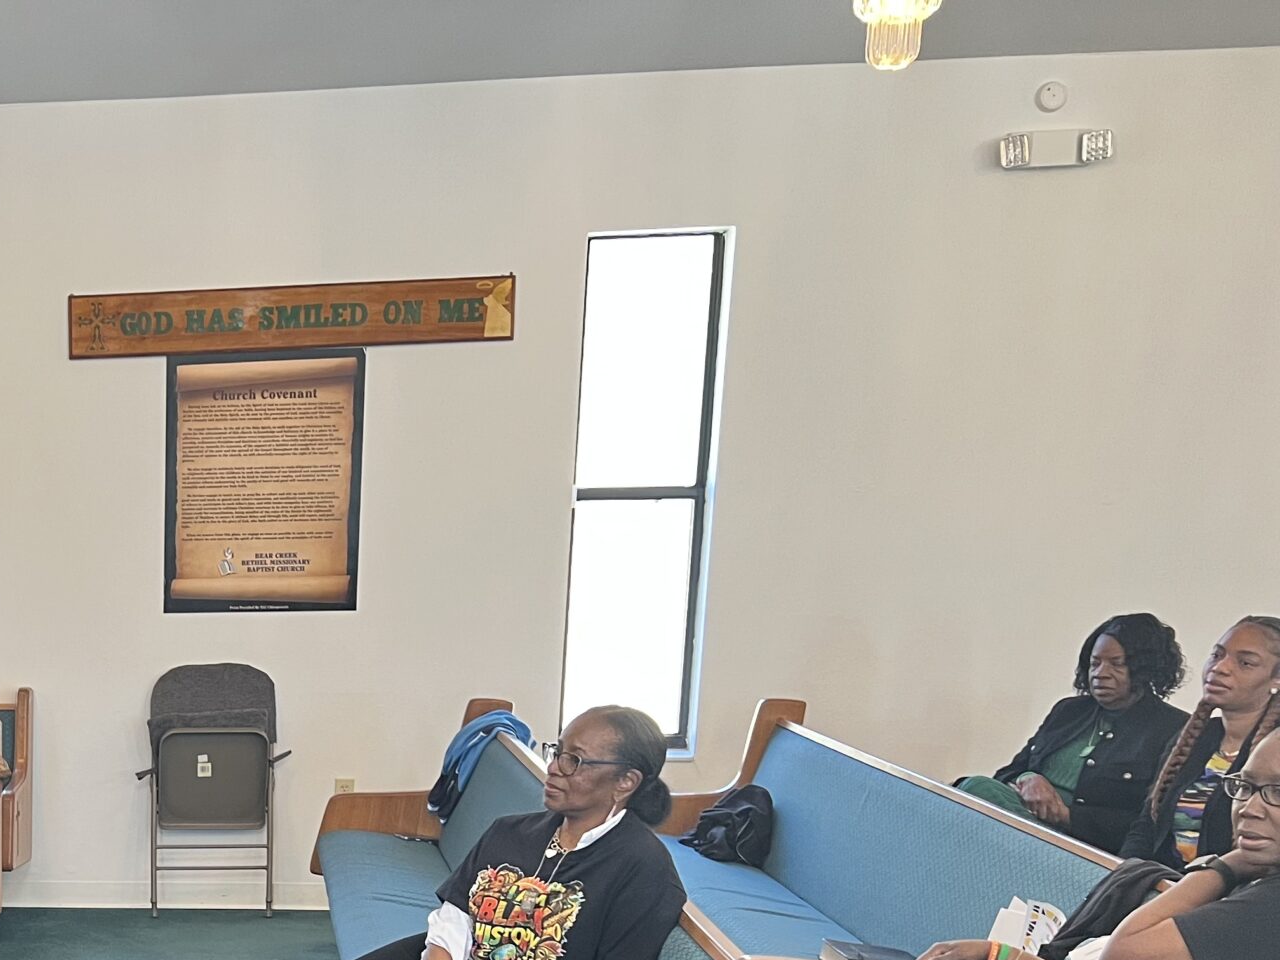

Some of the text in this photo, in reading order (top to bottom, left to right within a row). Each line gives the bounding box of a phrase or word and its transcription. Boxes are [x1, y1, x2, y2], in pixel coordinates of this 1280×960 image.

[120, 297, 485, 337] GOD HAS SMILED ON ME
[212, 388, 318, 401] Church Covenant
